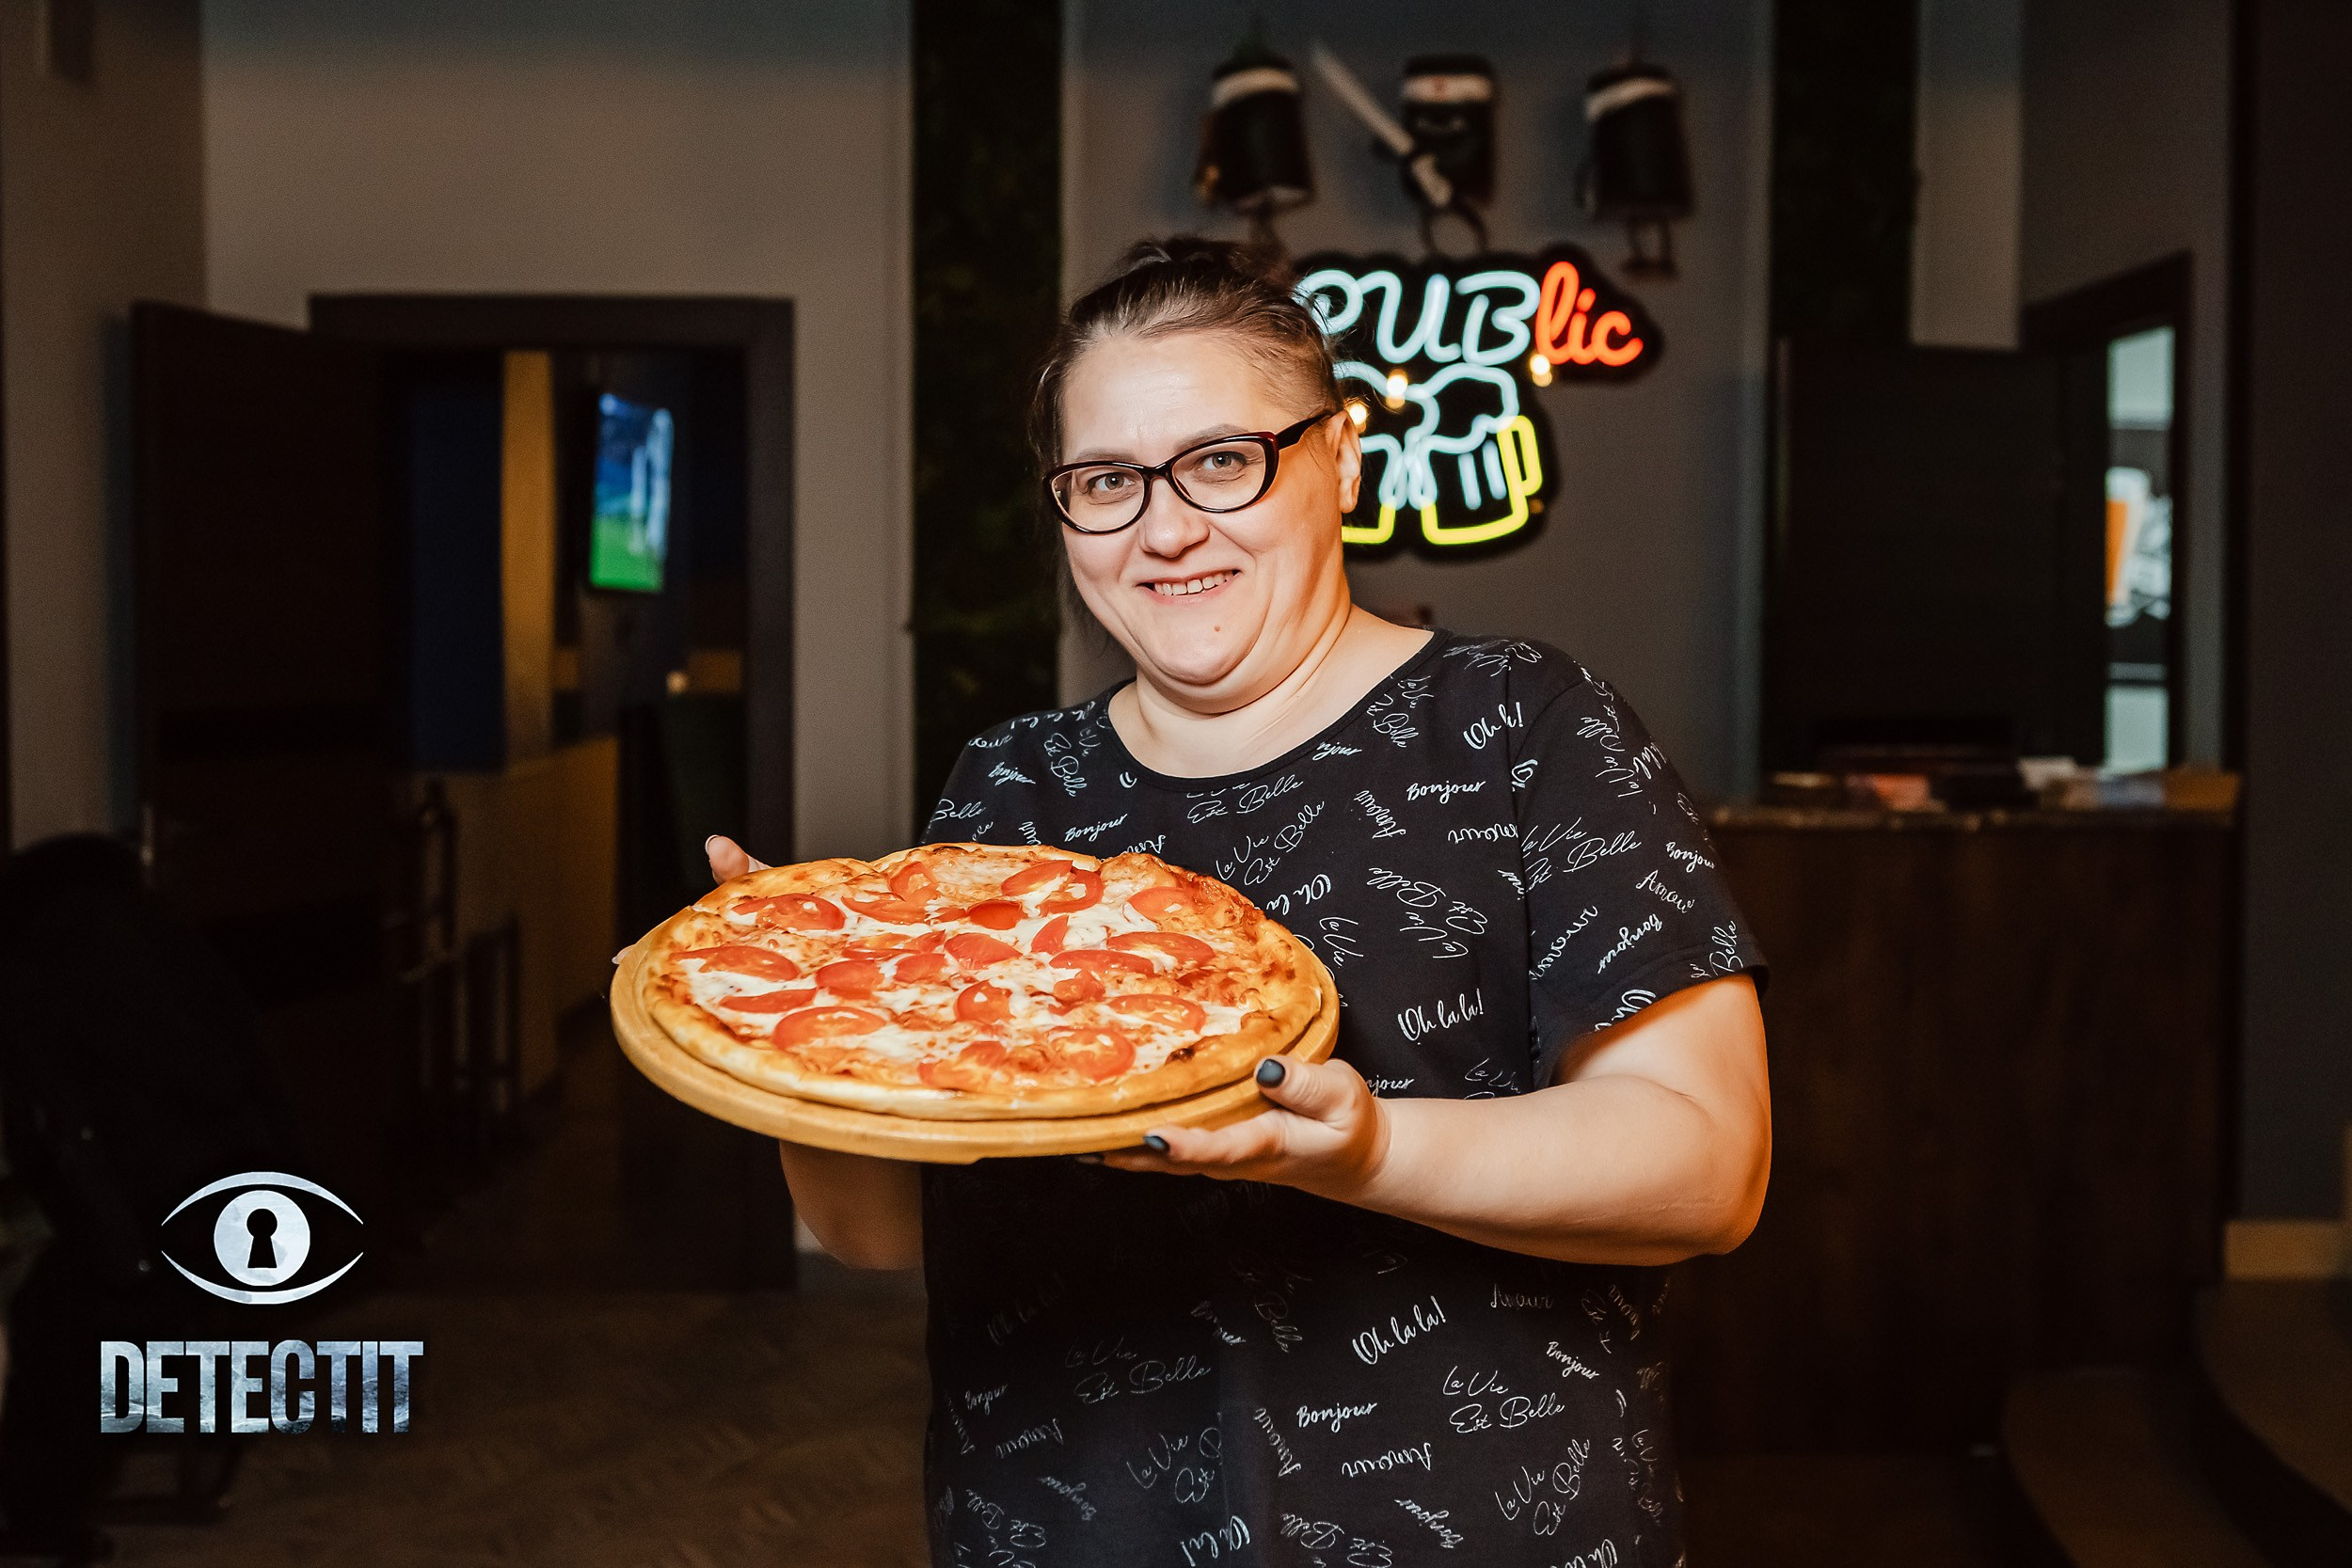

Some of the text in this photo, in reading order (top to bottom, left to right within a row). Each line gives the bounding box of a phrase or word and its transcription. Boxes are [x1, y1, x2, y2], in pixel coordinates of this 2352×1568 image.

[1311, 741, 1363, 762] njour
[1463, 717, 1502, 751] Oh
[1186, 800, 1229, 824] Est
[1236, 773, 1305, 815] Belle
[1406, 780, 1486, 804] Bonjour
[1064, 813, 1129, 843] Bonjour
[1244, 800, 1326, 886] Est Belle
[1233, 835, 1270, 863] Vie
[1563, 830, 1643, 873] Belle
[1366, 867, 1447, 908] Belle
[1397, 988, 1485, 1041] Oh la la!
[1352, 1294, 1447, 1366] Oh la la!
[1129, 1354, 1212, 1394] Belle
[1442, 1365, 1509, 1397] La Vie
[1545, 1340, 1601, 1381] Bonjour
[1295, 1402, 1378, 1433] Bonjour
[1449, 1391, 1565, 1433] Est Belle
[1341, 1442, 1433, 1479] Amour
[1495, 1465, 1546, 1522] La Vie
[1533, 1438, 1590, 1536] Est Belle
